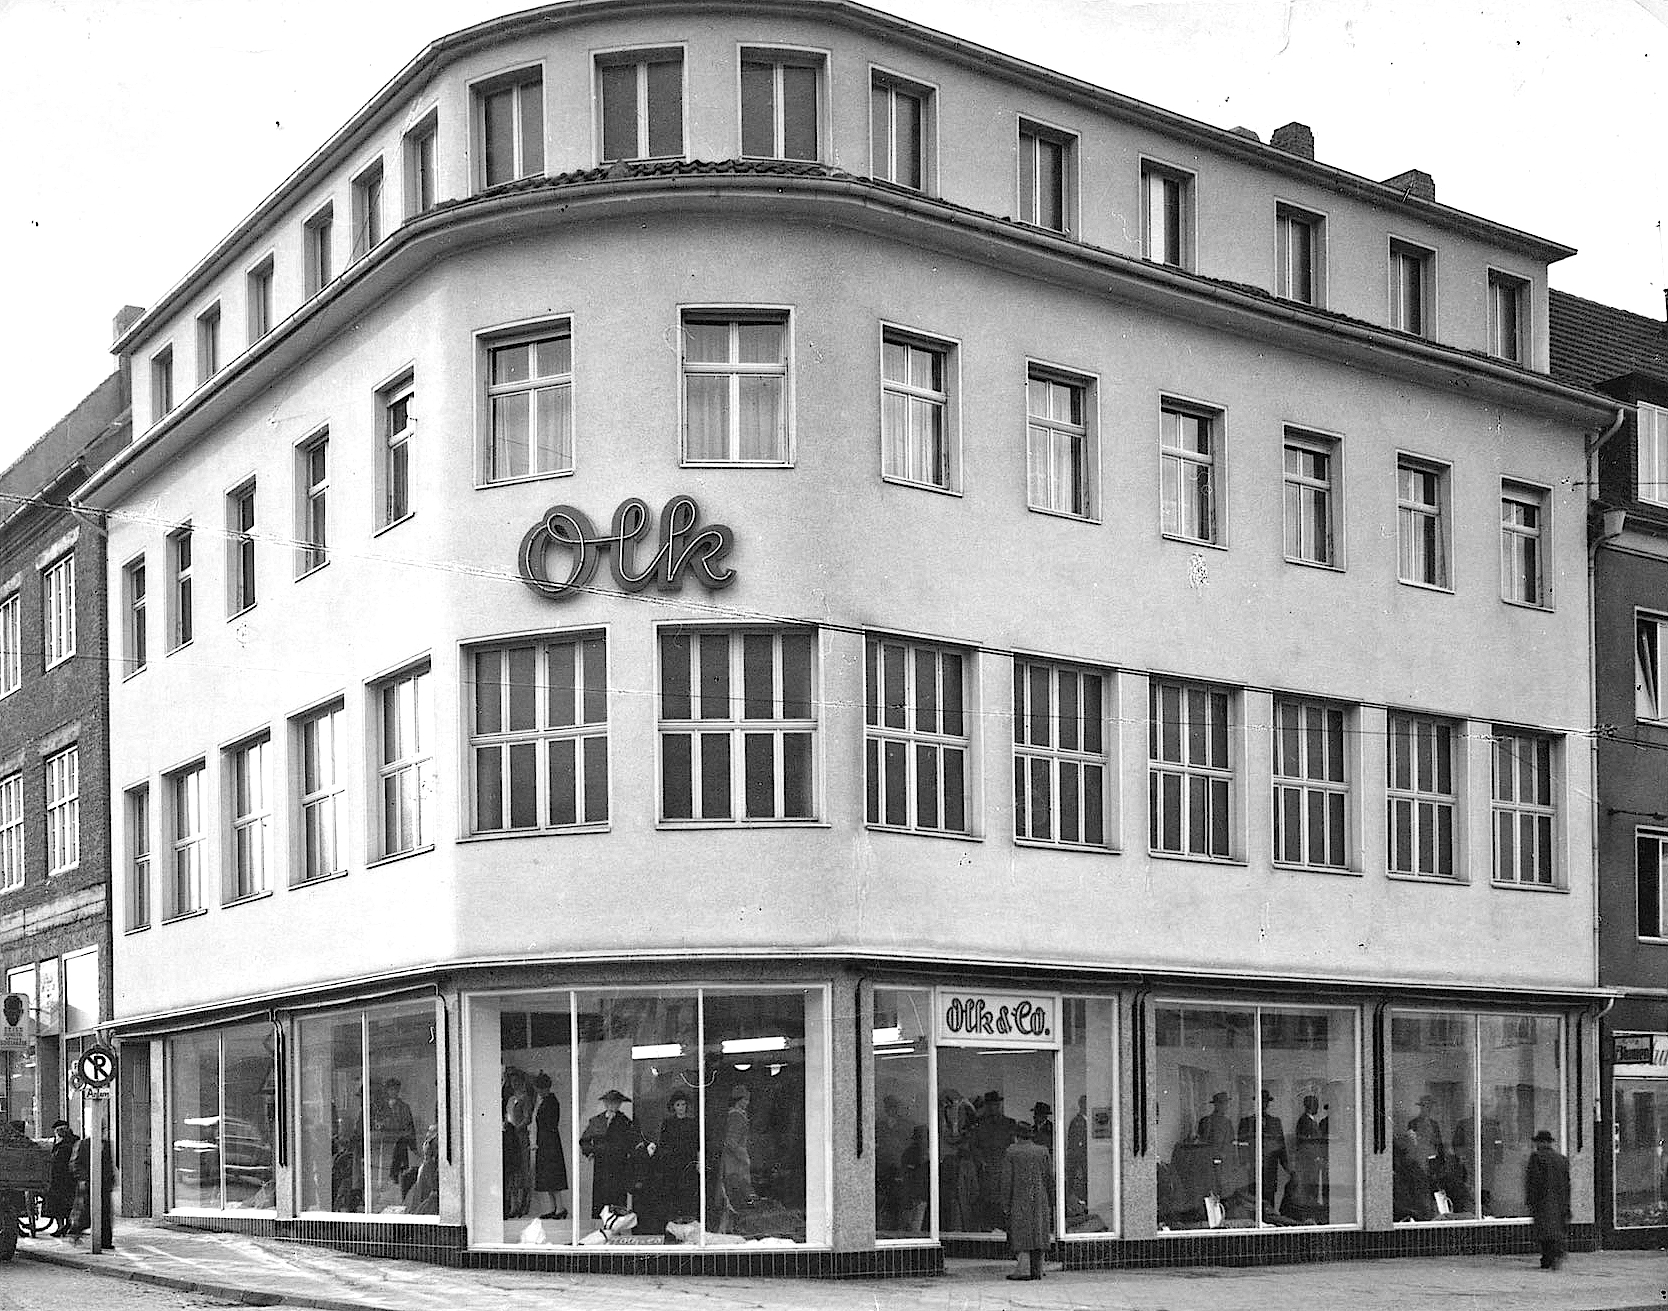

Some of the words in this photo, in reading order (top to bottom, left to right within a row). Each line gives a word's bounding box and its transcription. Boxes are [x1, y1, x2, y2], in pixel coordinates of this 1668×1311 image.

[518, 494, 737, 601] Olk
[946, 998, 994, 1035] Olk
[1011, 1000, 1051, 1036] Co.
